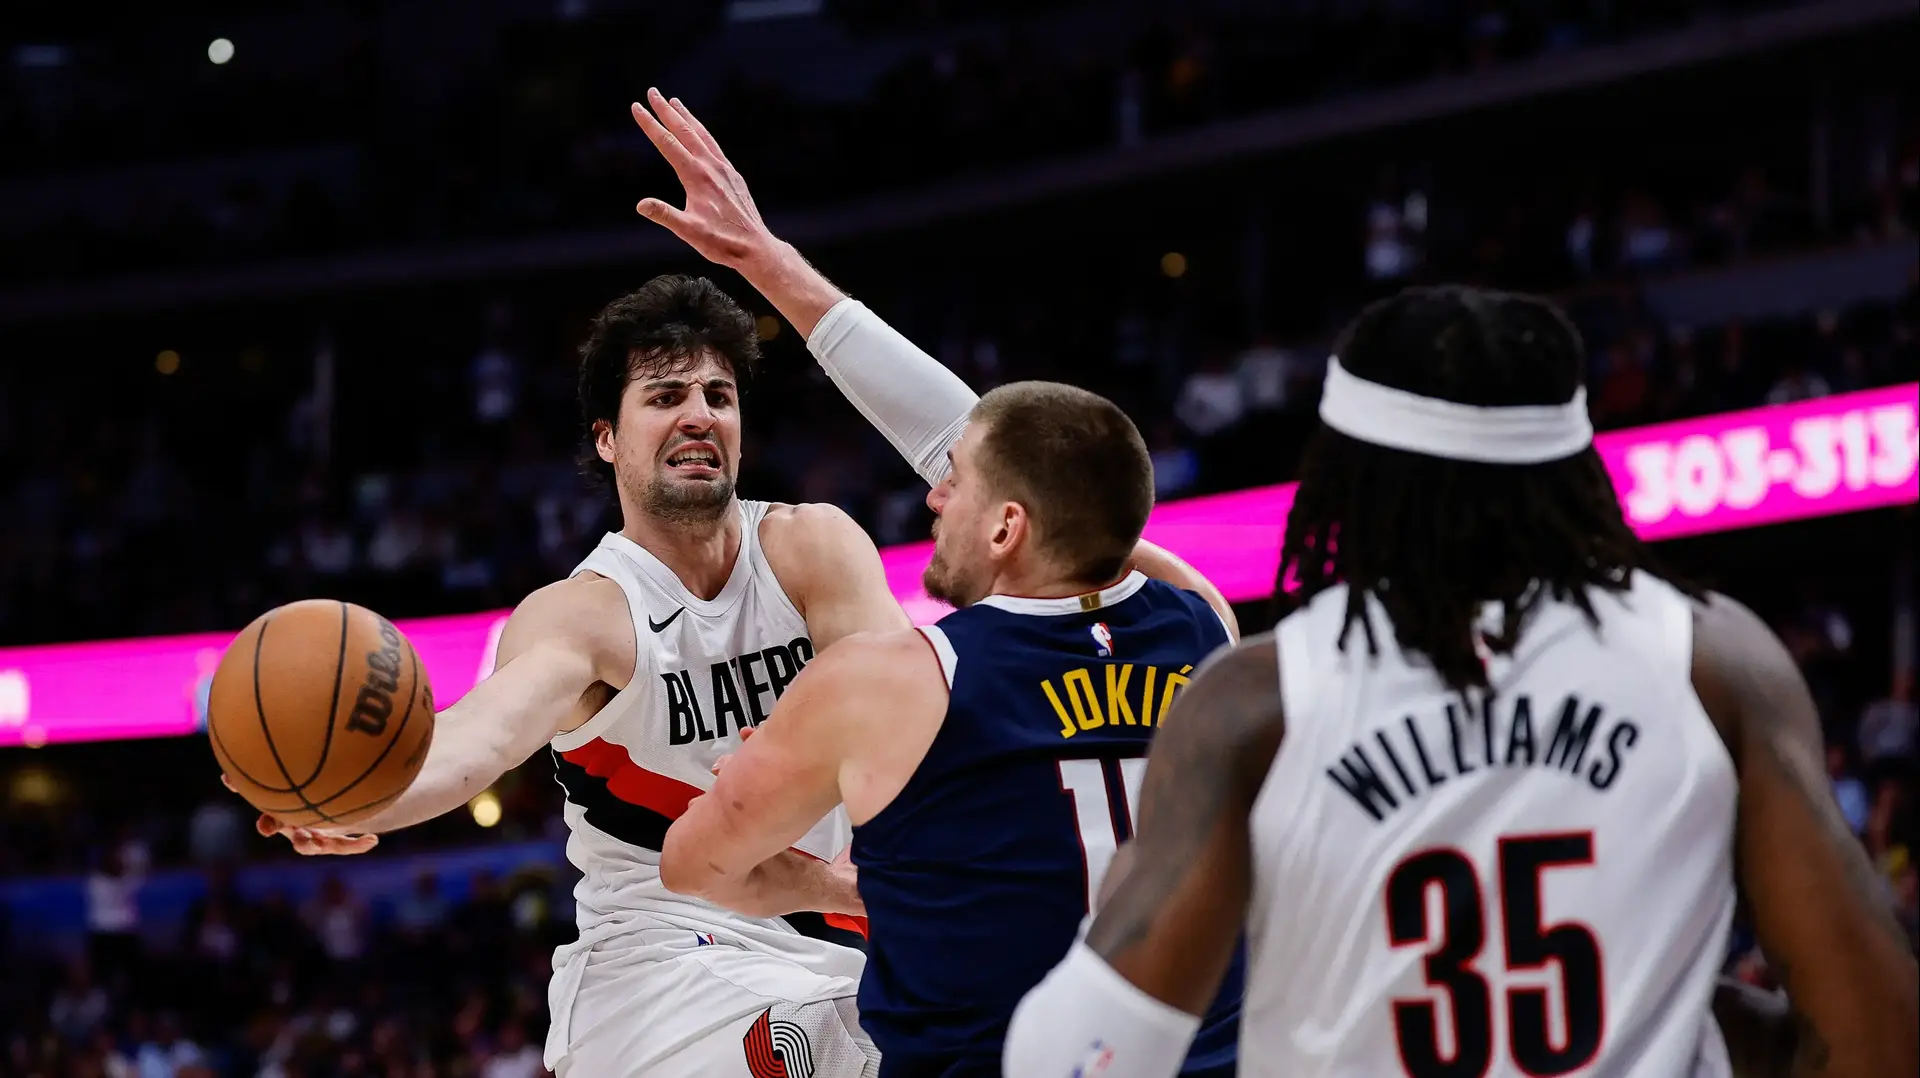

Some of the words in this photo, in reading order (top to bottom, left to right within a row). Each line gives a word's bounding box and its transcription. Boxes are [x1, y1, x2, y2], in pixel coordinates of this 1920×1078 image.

[1056, 755, 1150, 922] 1
[1326, 691, 1639, 821] WILLIAMS
[1382, 828, 1606, 1078] 35
